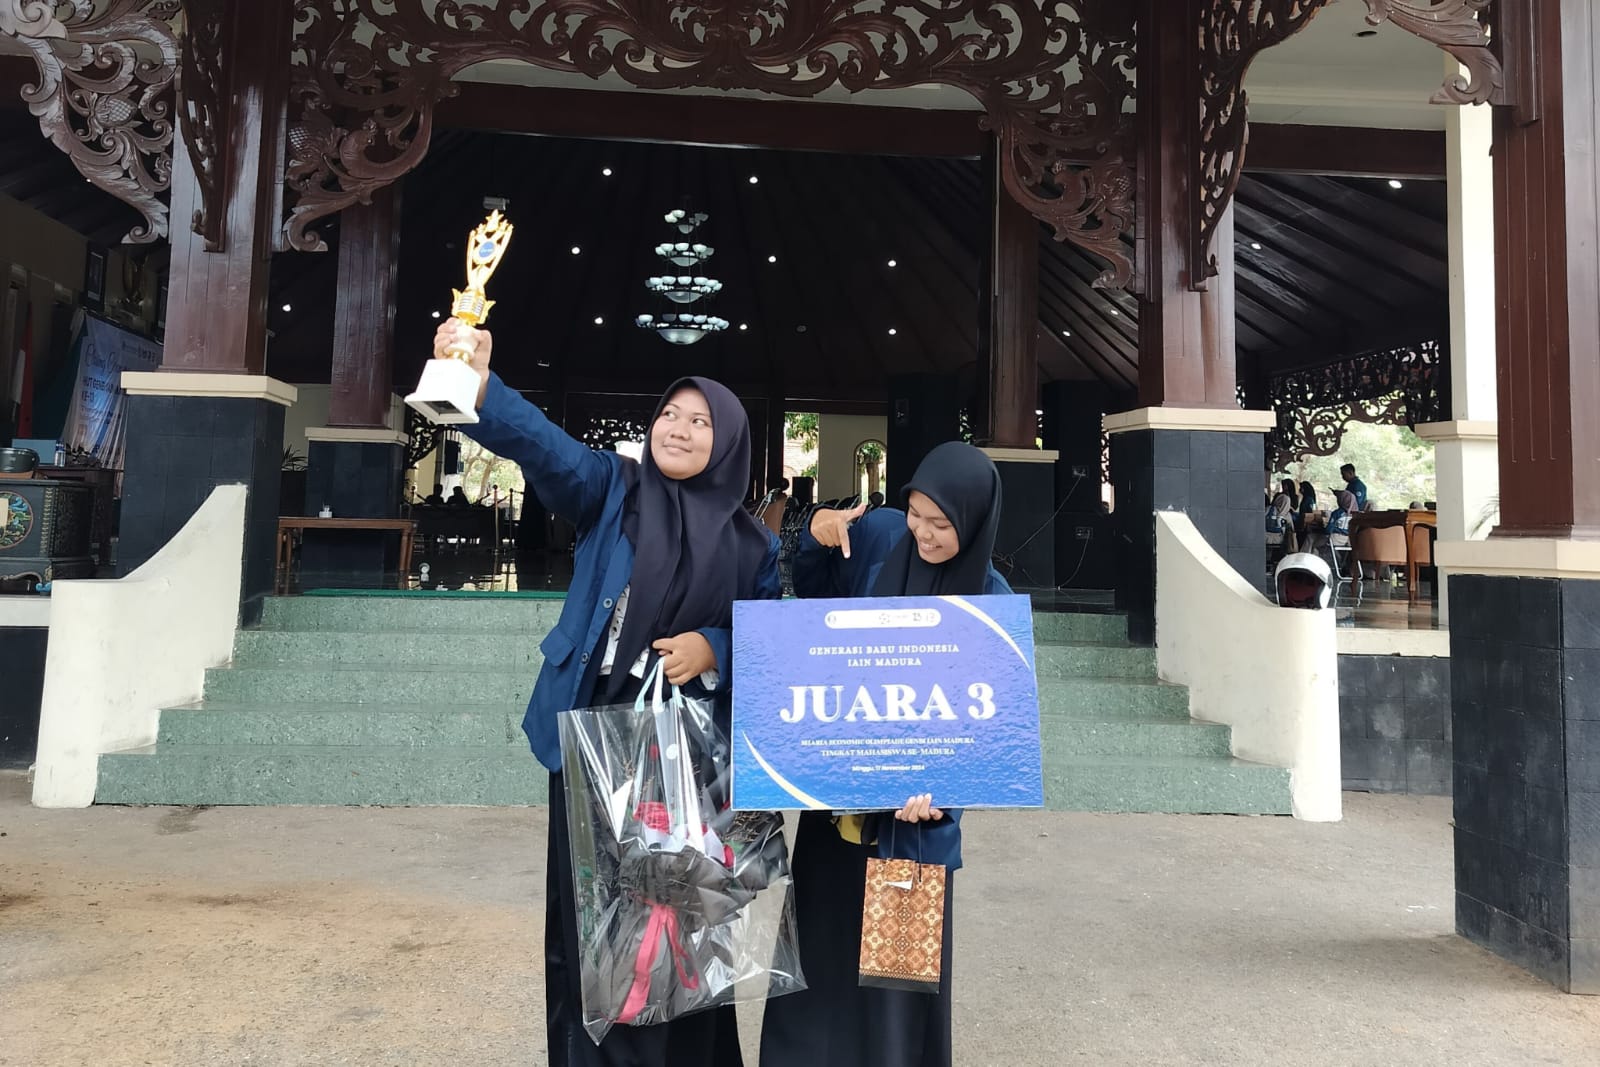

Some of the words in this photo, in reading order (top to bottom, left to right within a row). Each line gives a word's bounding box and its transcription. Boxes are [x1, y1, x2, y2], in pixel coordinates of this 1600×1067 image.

[809, 646, 863, 656] GENERASI
[866, 646, 895, 654] BARU
[898, 644, 959, 653] INDONESIA
[848, 659, 871, 667] IAIN
[875, 658, 922, 667] MADURA
[779, 683, 958, 723] JUARA
[967, 682, 996, 720] 3
[829, 738, 864, 746] ECONOMIC
[857, 748, 907, 756] MAHASISWA
